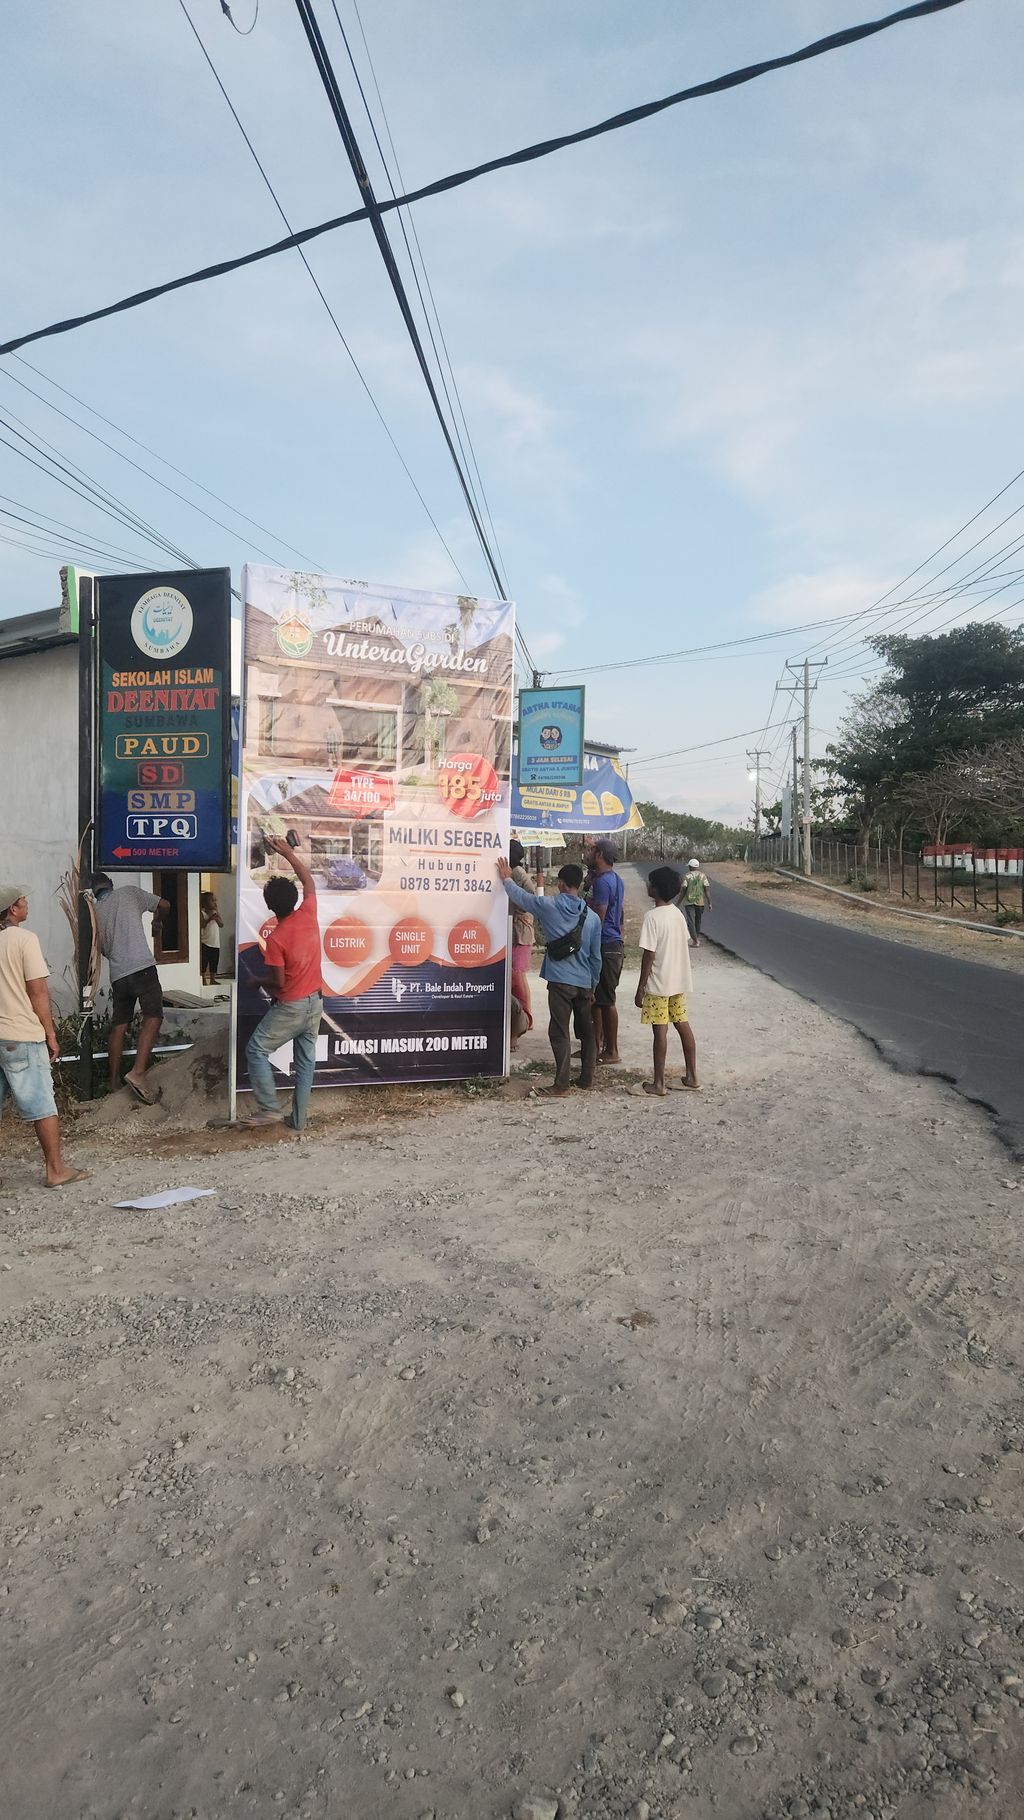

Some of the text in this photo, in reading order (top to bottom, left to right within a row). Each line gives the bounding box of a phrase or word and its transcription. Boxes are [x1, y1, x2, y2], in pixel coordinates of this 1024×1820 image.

[350, 621, 413, 640] PERUMAHAN
[112, 668, 214, 687] SEKOLAH ISLAM
[107, 688, 219, 713] DEENIYAT
[124, 714, 198, 729] SUMBAWA
[124, 737, 200, 755] PAUD
[438, 758, 472, 772] Harga
[142, 765, 180, 784] SD
[350, 775, 374, 789] TYPE
[440, 775, 481, 802] 185
[131, 792, 192, 810] SMP
[344, 789, 380, 804] 34/100
[480, 790, 502, 803] juta
[132, 818, 190, 838] TPQ
[390, 826, 438, 846] MILIKI
[444, 828, 502, 849] SEGERA
[132, 848, 179, 857] 500 METER
[418, 858, 477, 874] Hubungi
[400, 877, 492, 893] 0878 5271 3842
[396, 931, 426, 942] SINGLE
[462, 930, 477, 940] AIR
[330, 936, 366, 950] LISTRIK
[401, 944, 420, 955] UNIT
[454, 944, 485, 954] BERSIH
[410, 982, 494, 994] PT. Bale Indah Properti
[334, 1035, 488, 1055] LOKASI MASUK 200 METER
